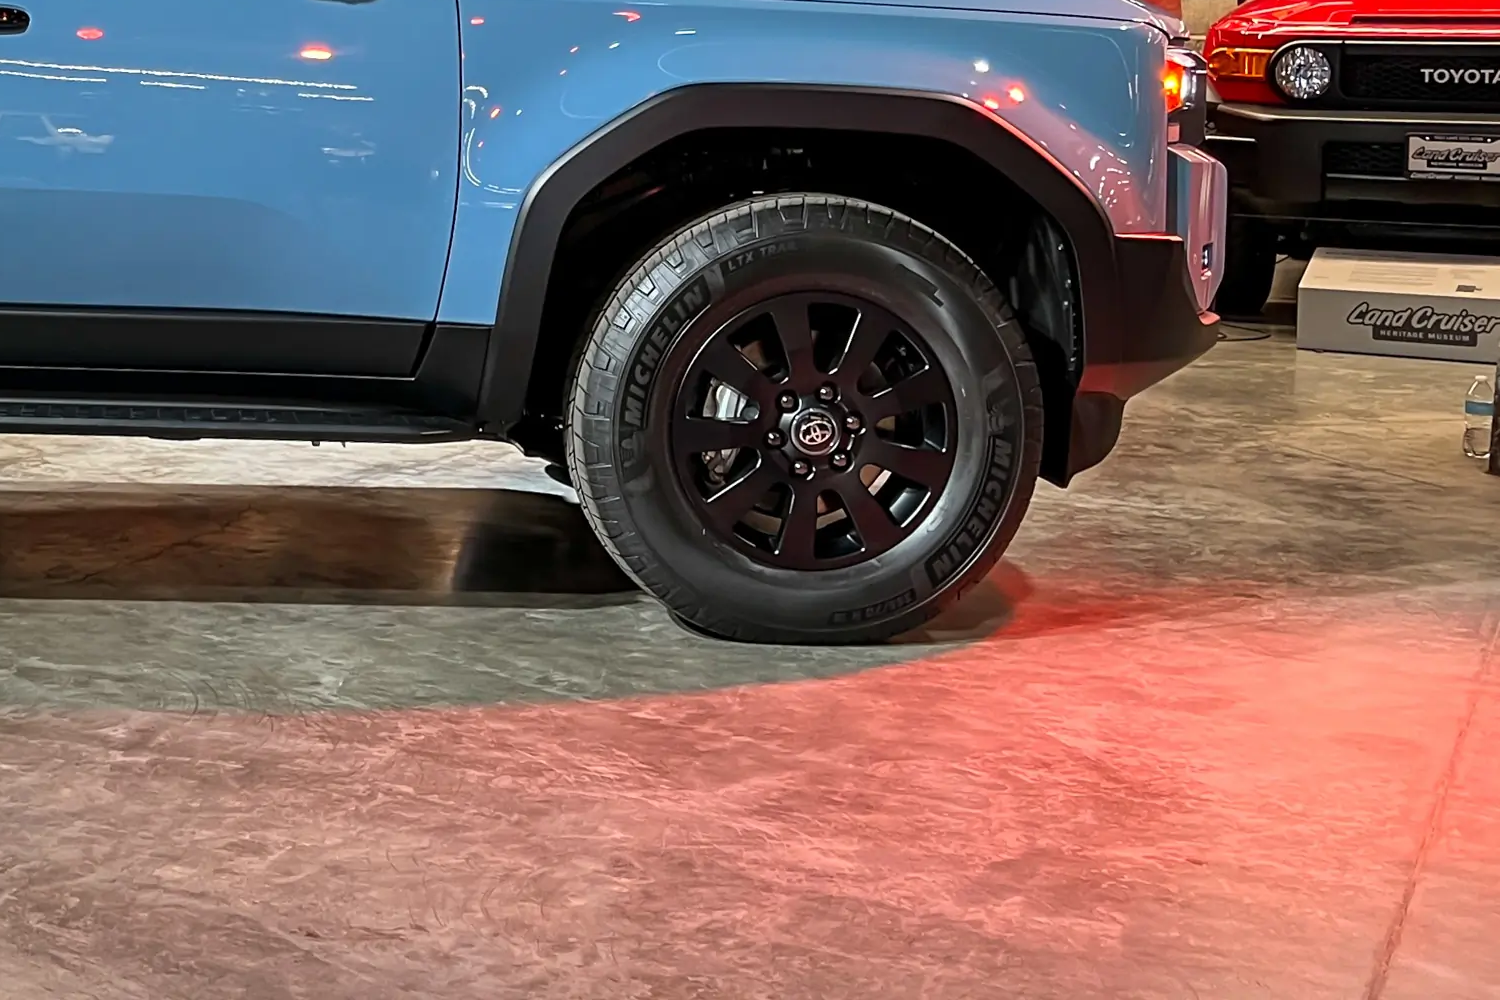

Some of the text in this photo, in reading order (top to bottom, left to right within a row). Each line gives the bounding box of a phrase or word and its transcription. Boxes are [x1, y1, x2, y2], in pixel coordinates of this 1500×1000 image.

[623, 282, 703, 428] MICHELIN
[1347, 302, 1500, 334] Land Cruiser
[1379, 329, 1471, 343] HERITAGE MUSEUM
[931, 436, 1014, 578] MICHELIN
